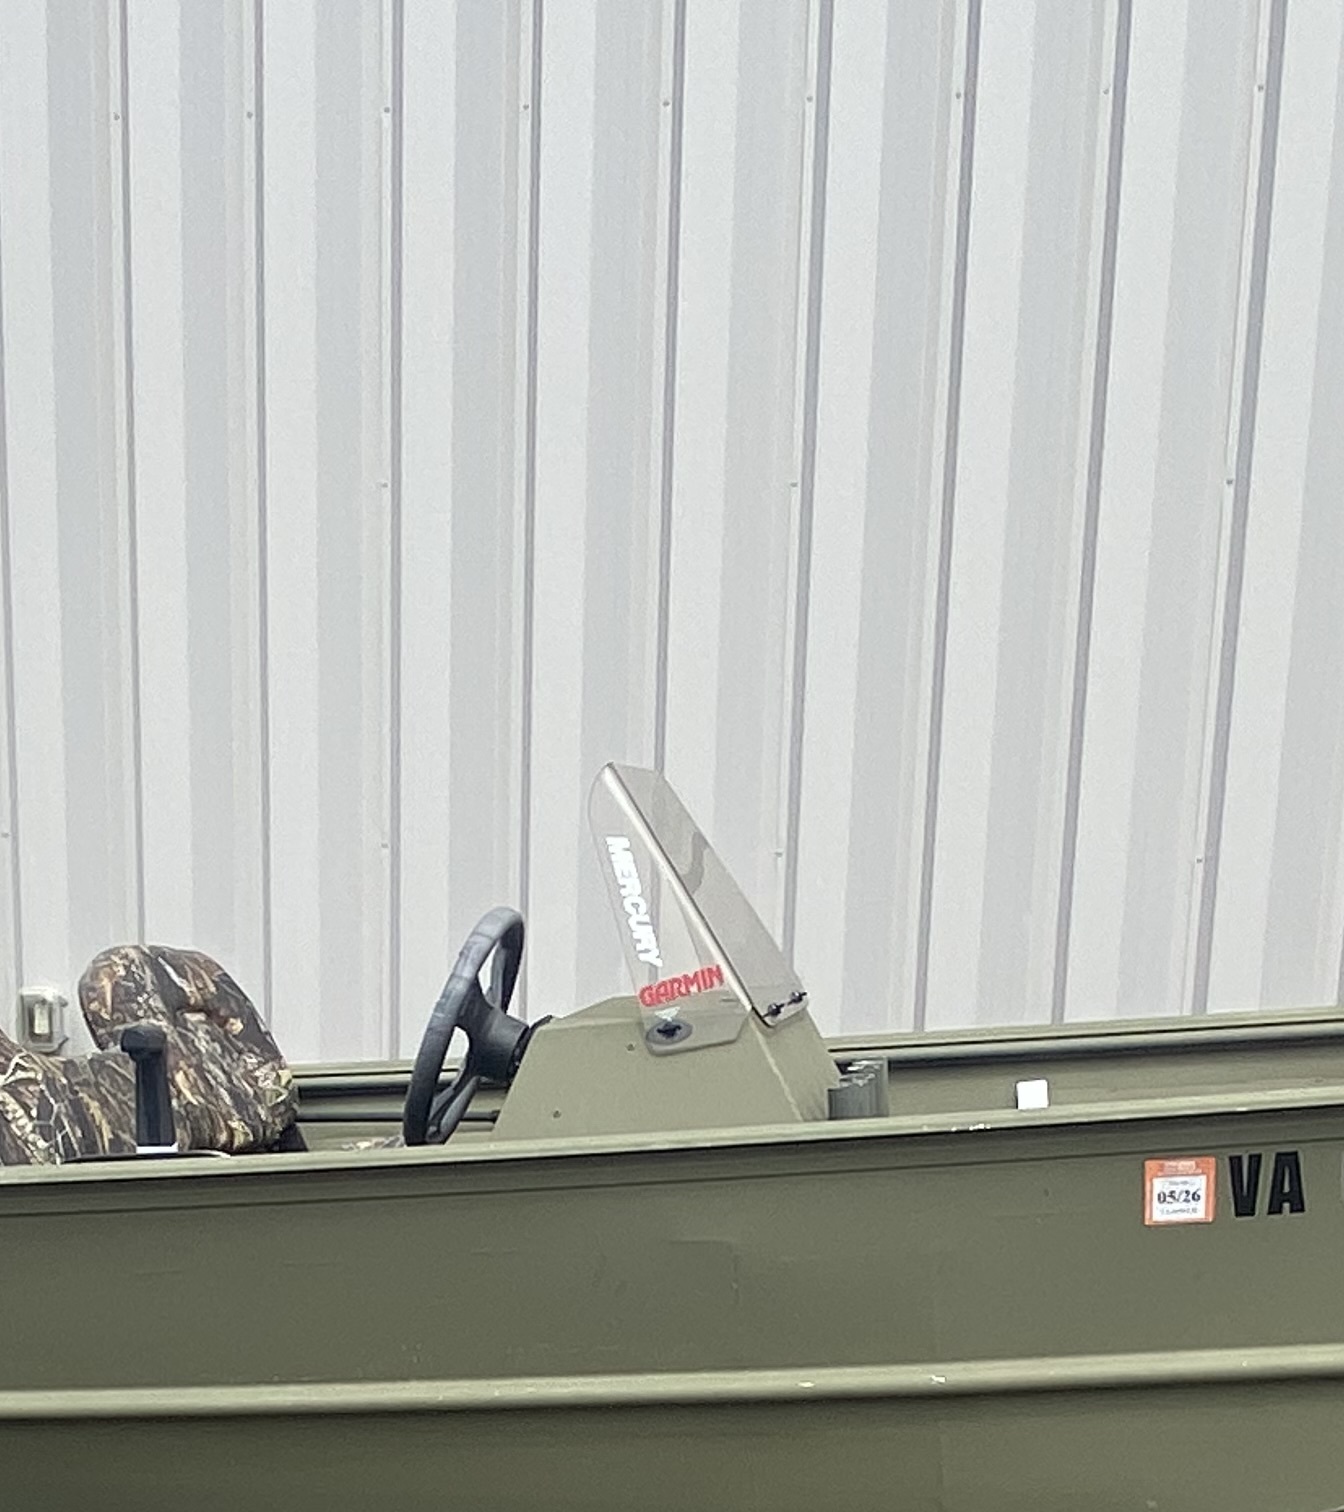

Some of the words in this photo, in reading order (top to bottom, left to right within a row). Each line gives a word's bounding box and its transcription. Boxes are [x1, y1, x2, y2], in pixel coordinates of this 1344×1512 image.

[606, 836, 663, 967] MERCURY
[639, 965, 726, 1007] GARMIN
[1156, 1187, 1202, 1205] 05/26
[1228, 1150, 1307, 1218] VA
